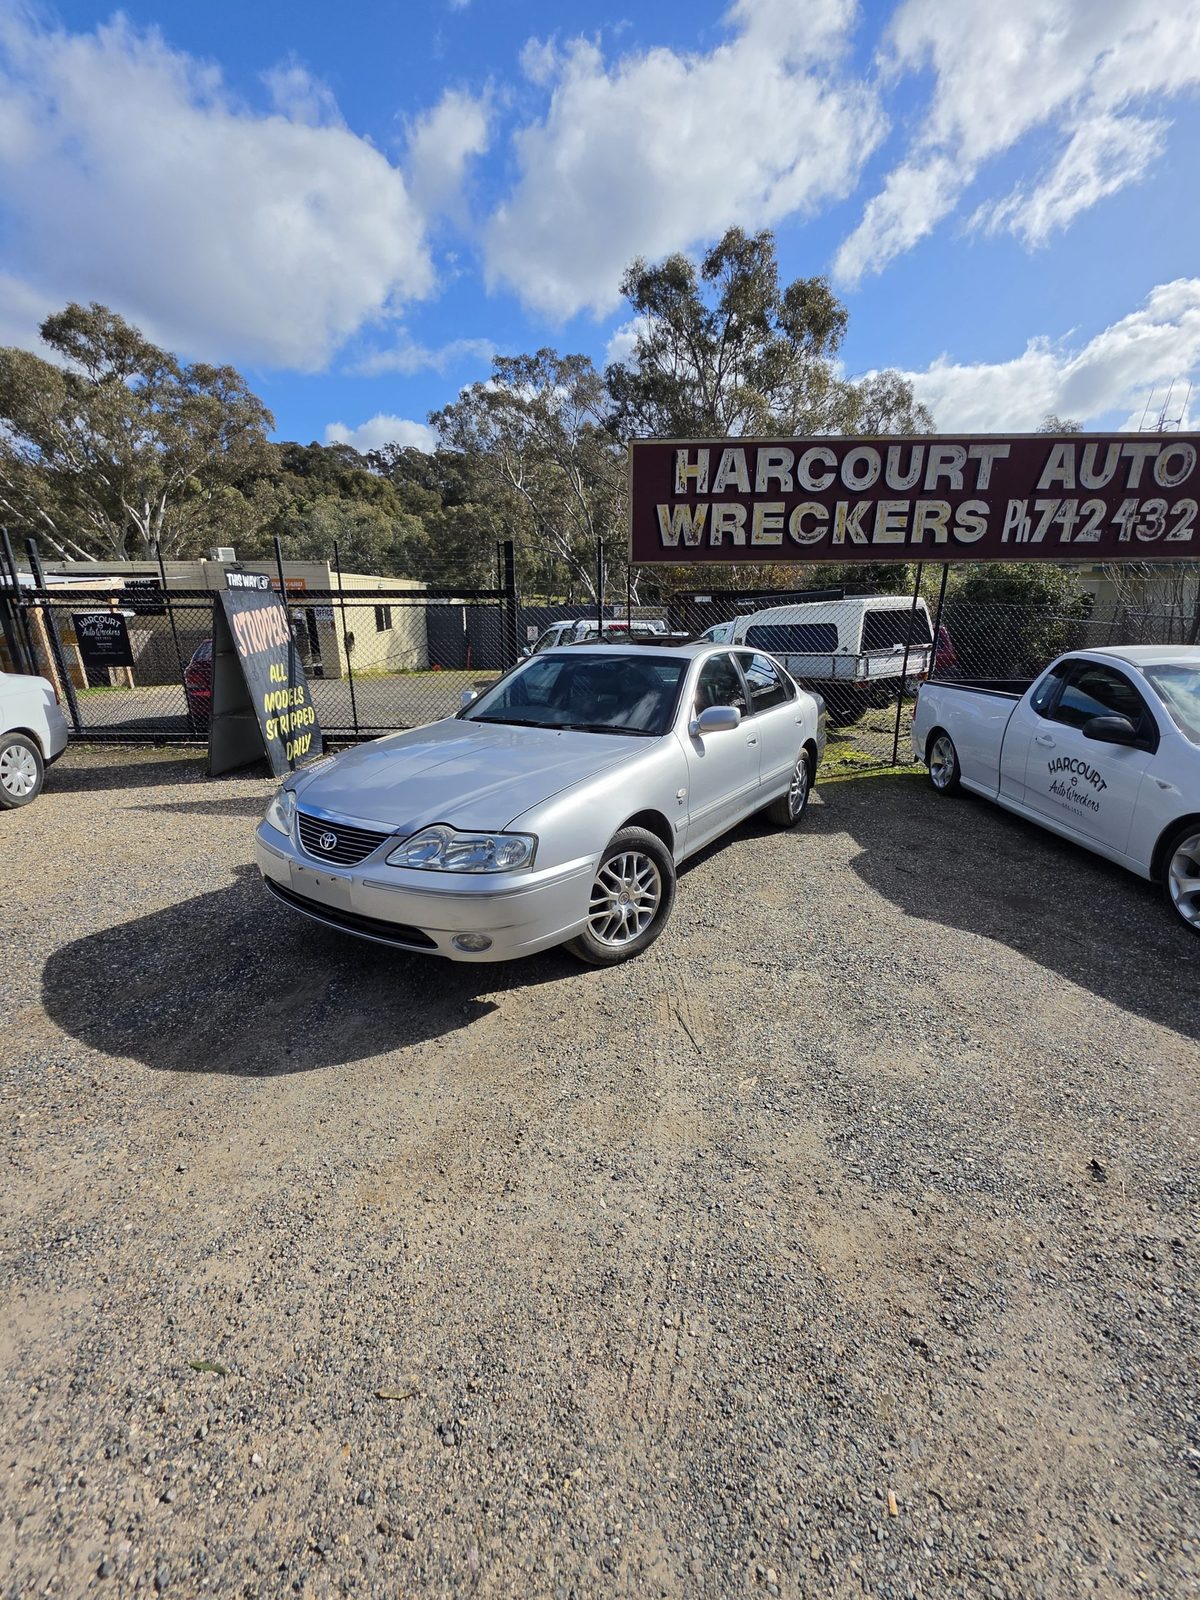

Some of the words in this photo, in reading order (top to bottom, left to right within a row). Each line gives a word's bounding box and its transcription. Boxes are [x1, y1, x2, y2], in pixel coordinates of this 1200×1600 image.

[674, 443, 1011, 495] HARCOURT
[1036, 442, 1197, 490] AUTO
[656, 499, 991, 547] WRECKERS
[1111, 498, 1199, 542] 432
[226, 573, 243, 587] THIS
[242, 575, 258, 588] WAY
[78, 615, 121, 628] HARCOURT
[232, 604, 292, 658] STRIPPERS
[269, 663, 288, 683] ALL
[264, 685, 305, 713] MODELS
[266, 706, 315, 740] STRIPPED
[286, 732, 312, 760] DAILY
[1048, 757, 1107, 792] HARCOURT
